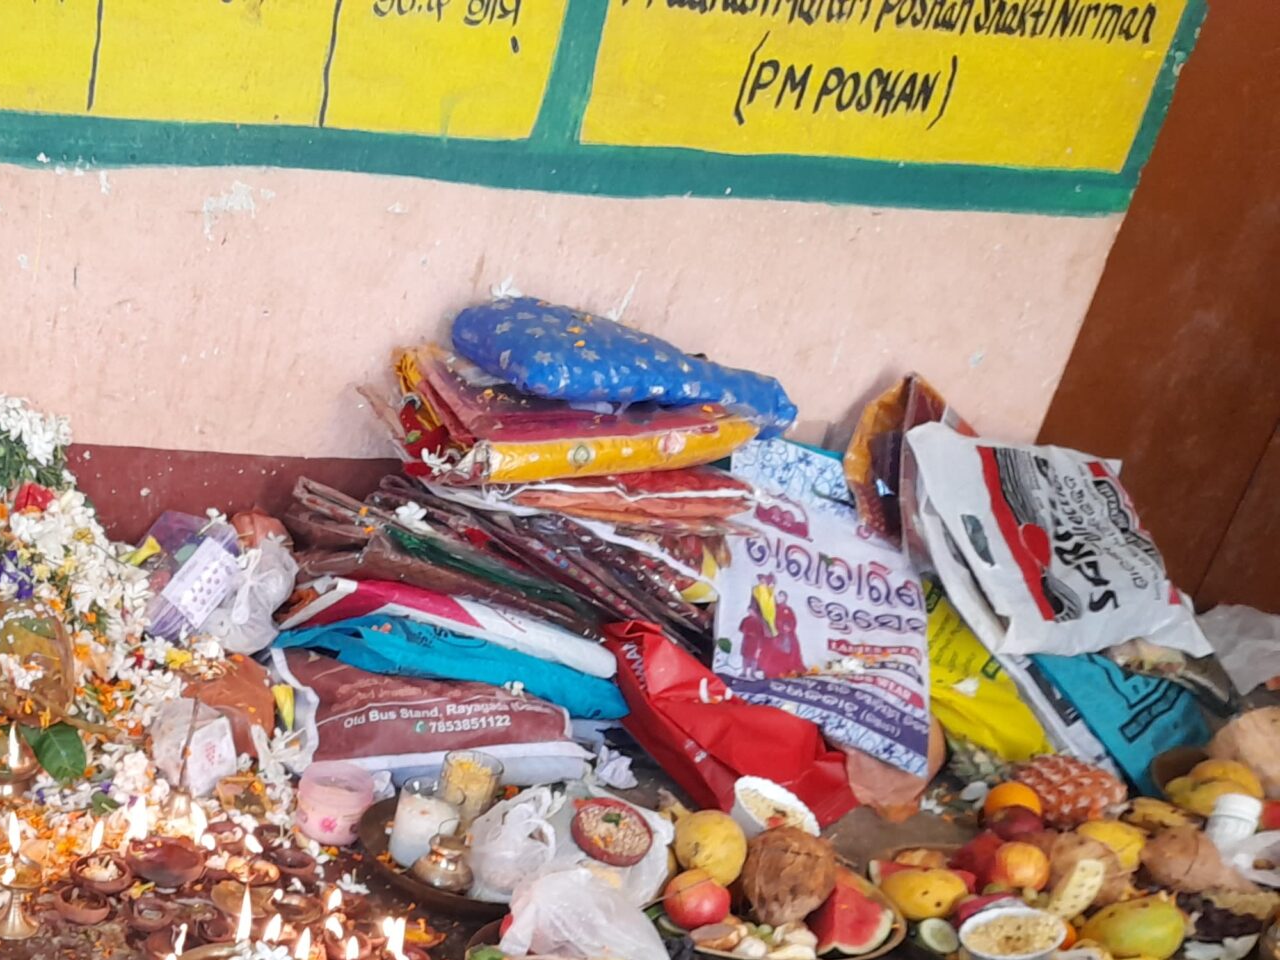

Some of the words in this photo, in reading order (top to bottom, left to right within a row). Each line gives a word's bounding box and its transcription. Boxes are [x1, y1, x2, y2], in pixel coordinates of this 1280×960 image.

[1048, 0, 1157, 44] Nirman
[343, 716, 366, 729] Old
[369, 710, 397, 722] Bus
